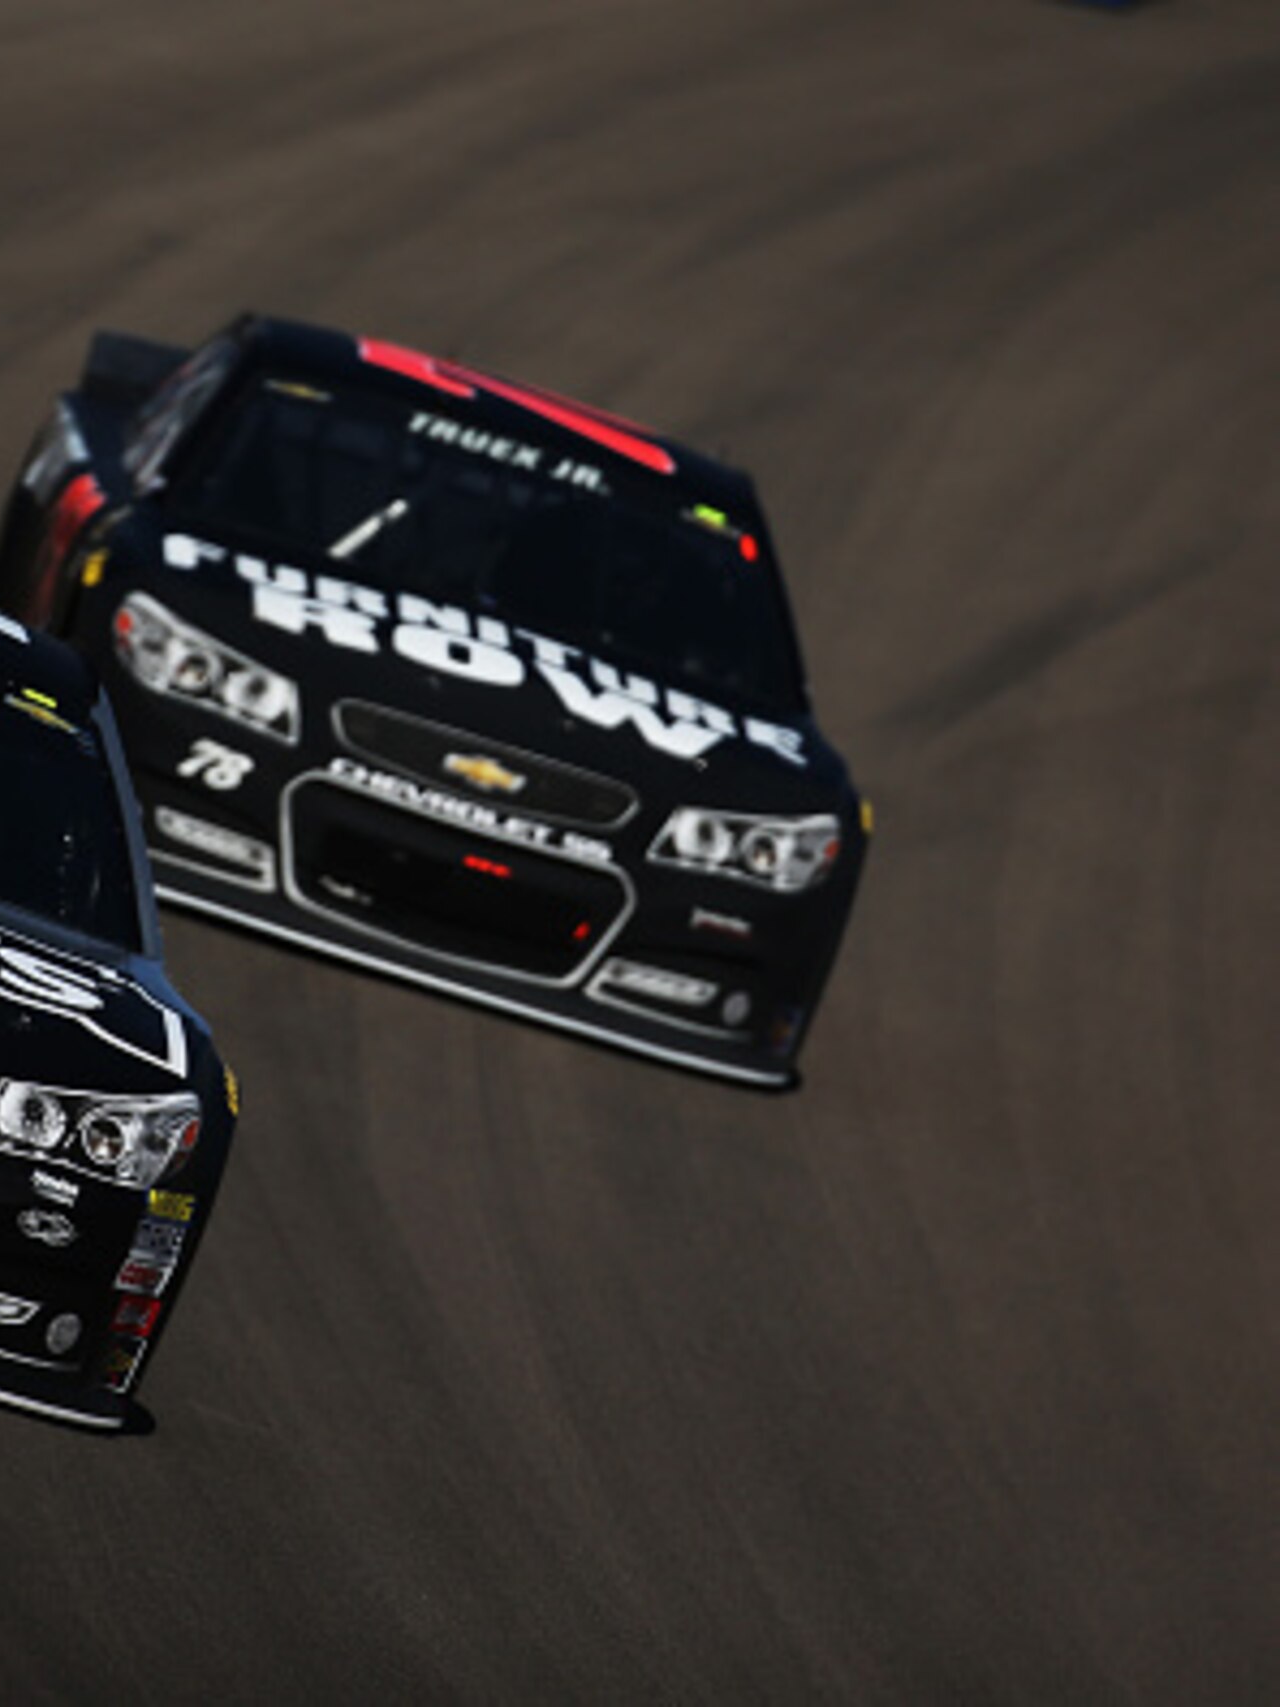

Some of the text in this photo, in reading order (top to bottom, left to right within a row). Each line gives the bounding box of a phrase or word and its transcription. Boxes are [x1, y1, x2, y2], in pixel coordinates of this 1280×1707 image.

[163, 533, 808, 766] FURNITURE
[253, 583, 723, 760] ROW
[177, 738, 255, 791] 78
[329, 757, 556, 846] CHEVROLET
